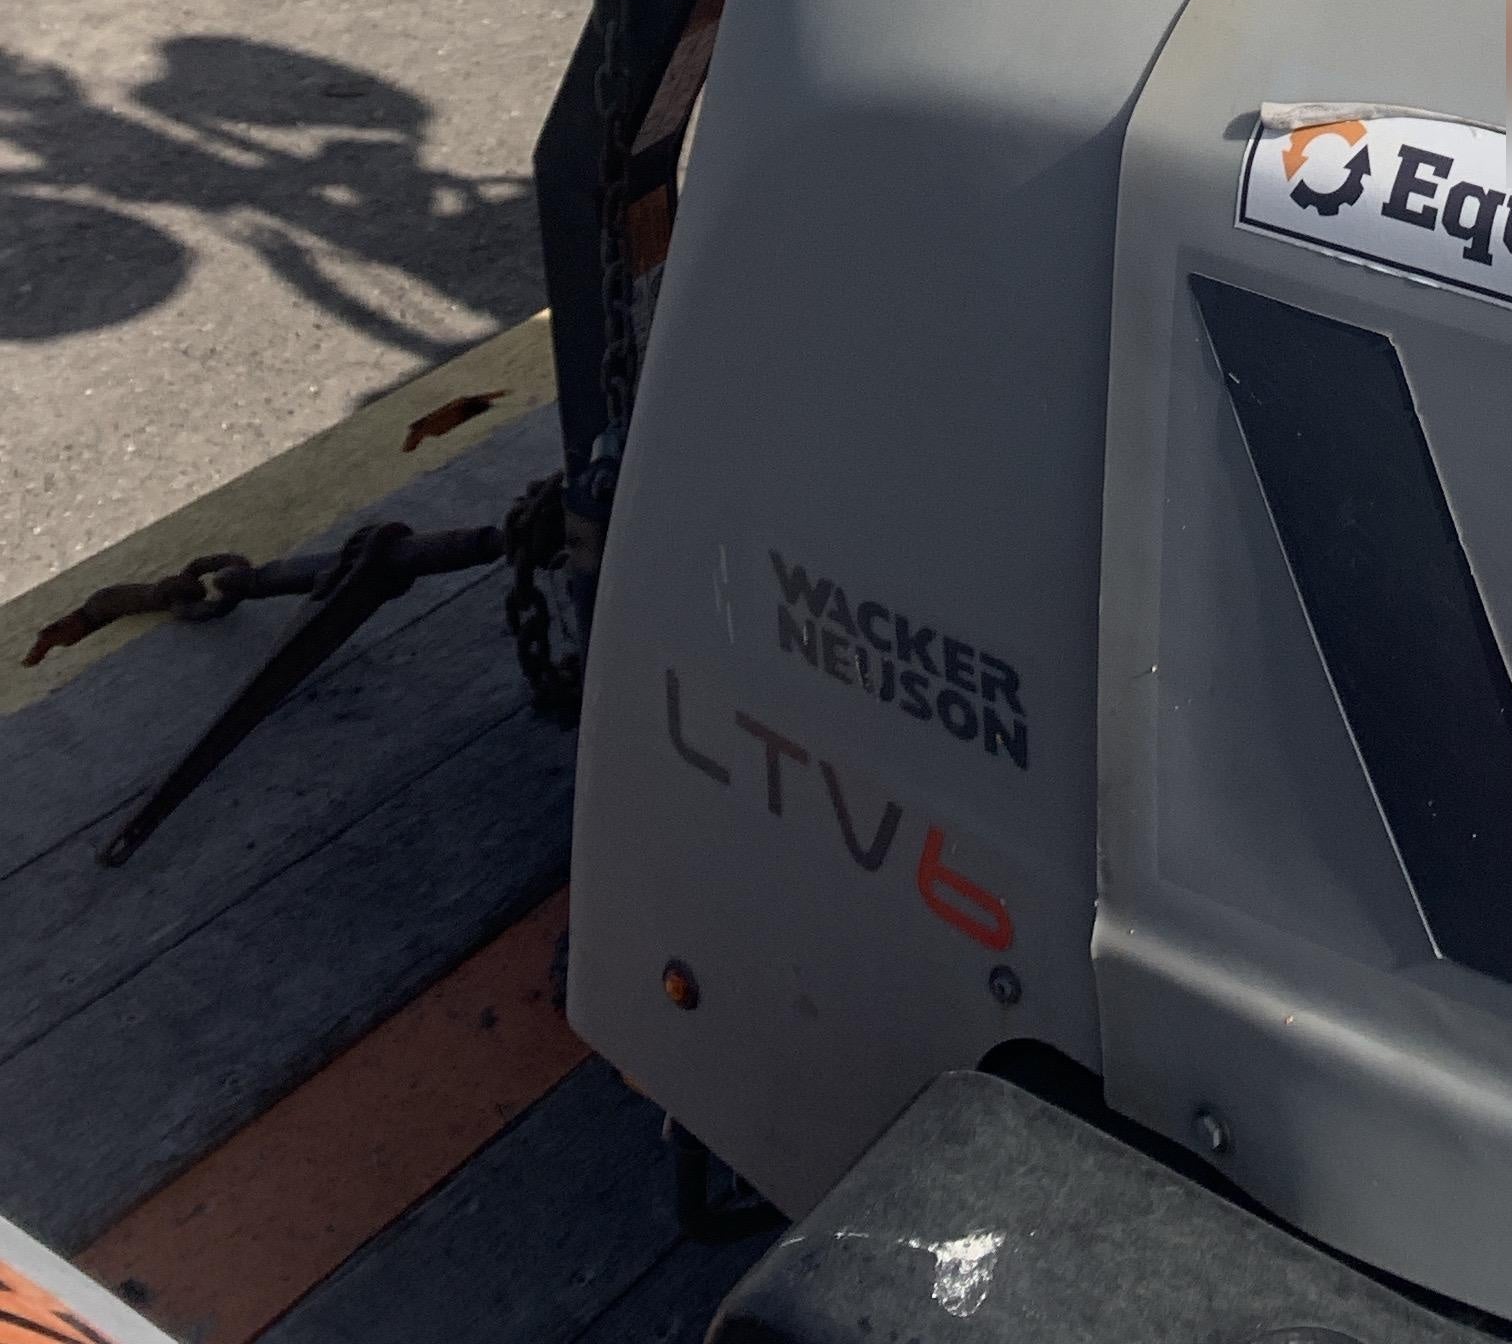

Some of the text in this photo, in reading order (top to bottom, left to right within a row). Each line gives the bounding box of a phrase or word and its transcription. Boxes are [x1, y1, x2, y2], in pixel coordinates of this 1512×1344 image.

[768, 548, 1023, 718] WACKER
[775, 604, 1029, 772] NEUSON
[664, 667, 1016, 952] LTV6
